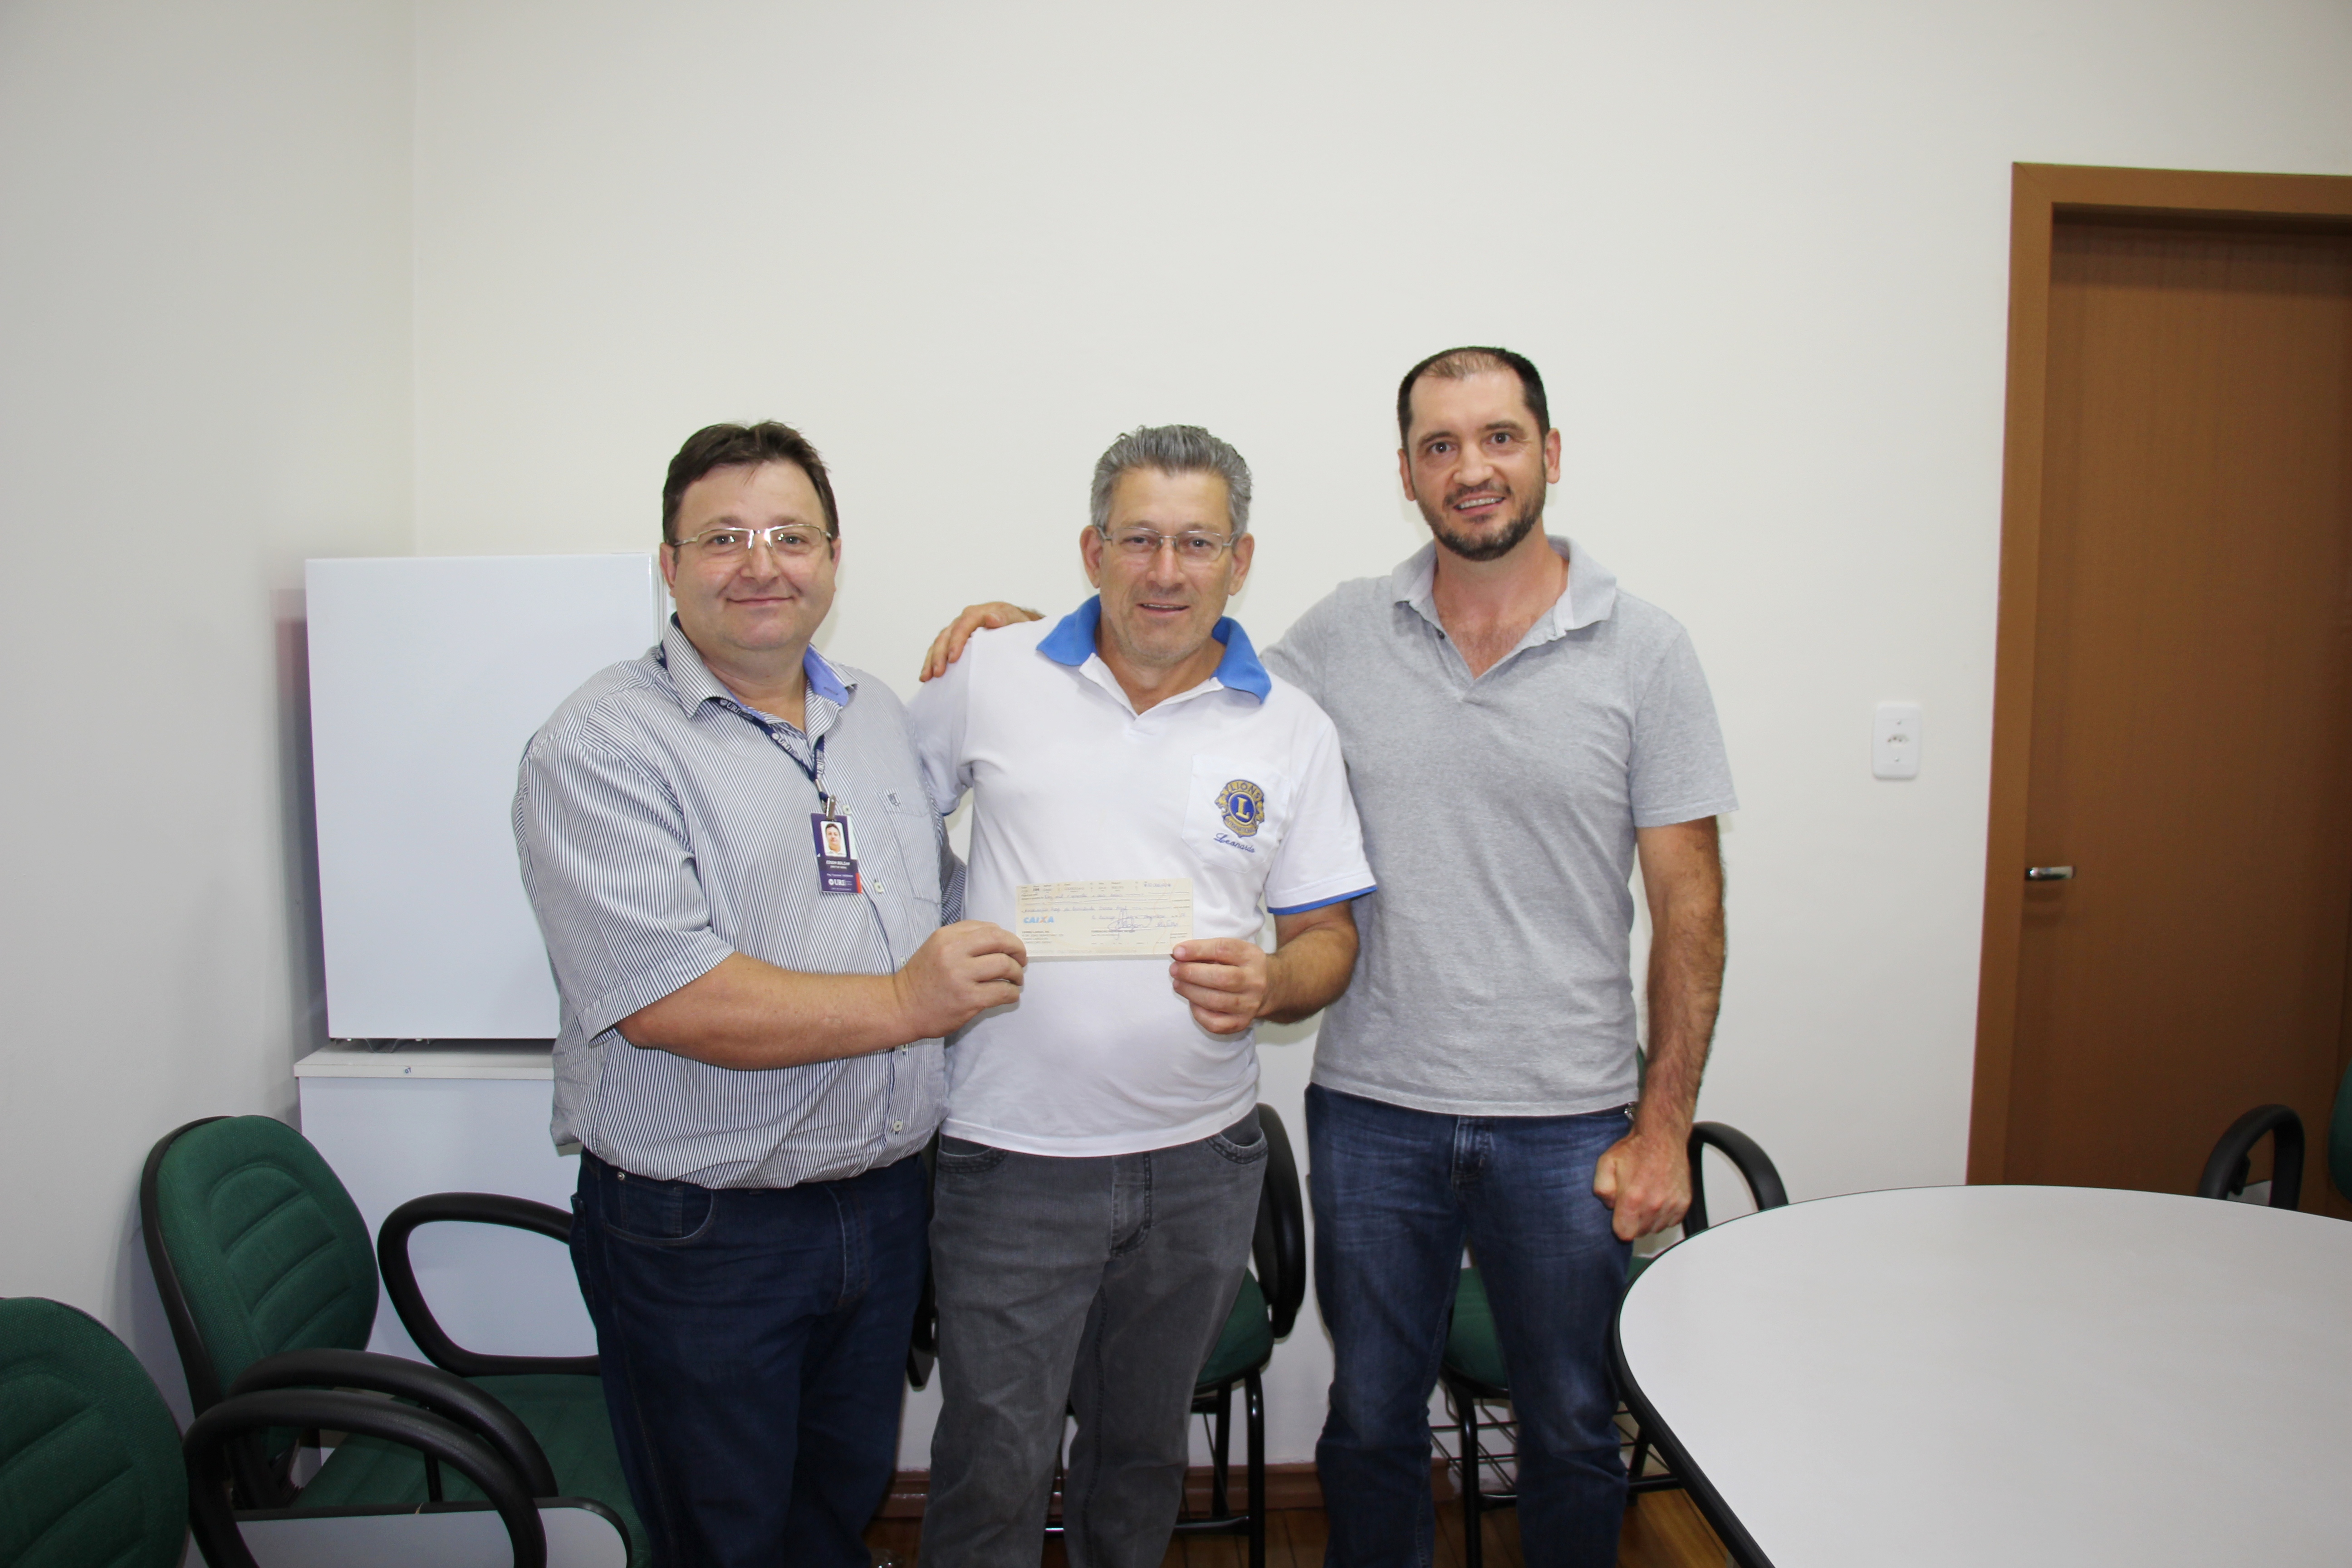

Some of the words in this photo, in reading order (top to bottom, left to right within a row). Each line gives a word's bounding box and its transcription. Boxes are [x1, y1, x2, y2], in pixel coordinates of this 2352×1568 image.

[726, 702, 740, 713] URI
[778, 738, 790, 750] URI
[817, 761, 825, 774] URI
[1230, 782, 1262, 799] LIONS
[1235, 797, 1250, 820] L
[1023, 916, 1054, 924] CAIXA
